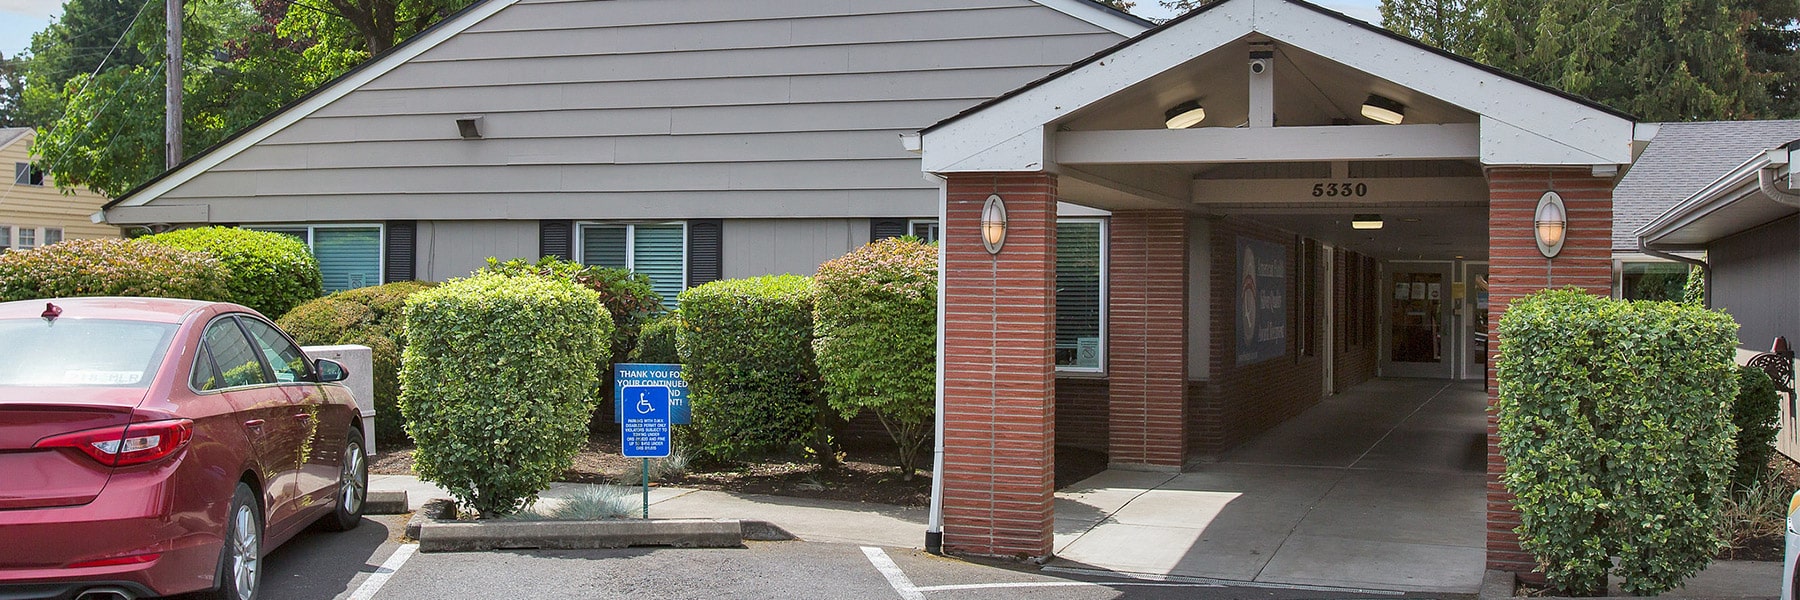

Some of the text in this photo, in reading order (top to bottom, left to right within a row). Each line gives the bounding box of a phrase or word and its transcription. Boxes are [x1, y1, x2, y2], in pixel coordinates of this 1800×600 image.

[1312, 183, 1367, 197] 5330
[620, 370, 680, 378] THANK YOU FO
[641, 380, 688, 388] CONTINUED
[669, 389, 680, 397] ND
